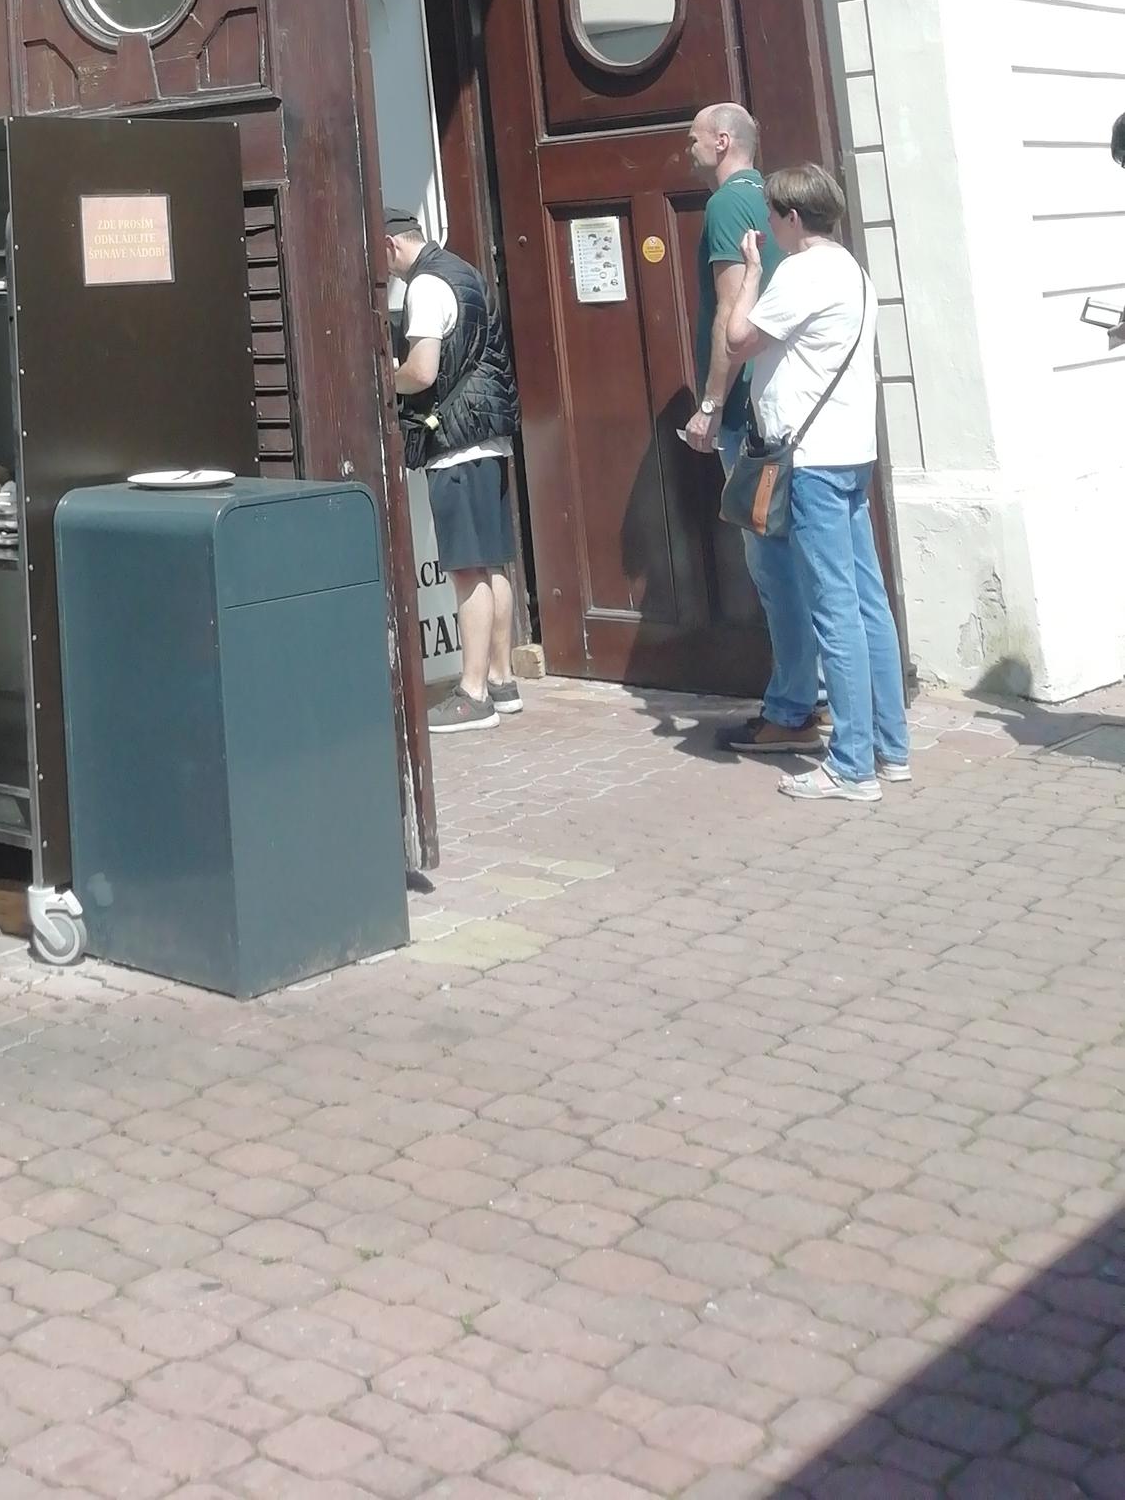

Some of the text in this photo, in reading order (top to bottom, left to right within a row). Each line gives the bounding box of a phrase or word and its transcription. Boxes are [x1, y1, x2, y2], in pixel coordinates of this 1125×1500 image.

[97, 216, 154, 230] ZDE PROSÍM
[417, 560, 447, 588] CE
